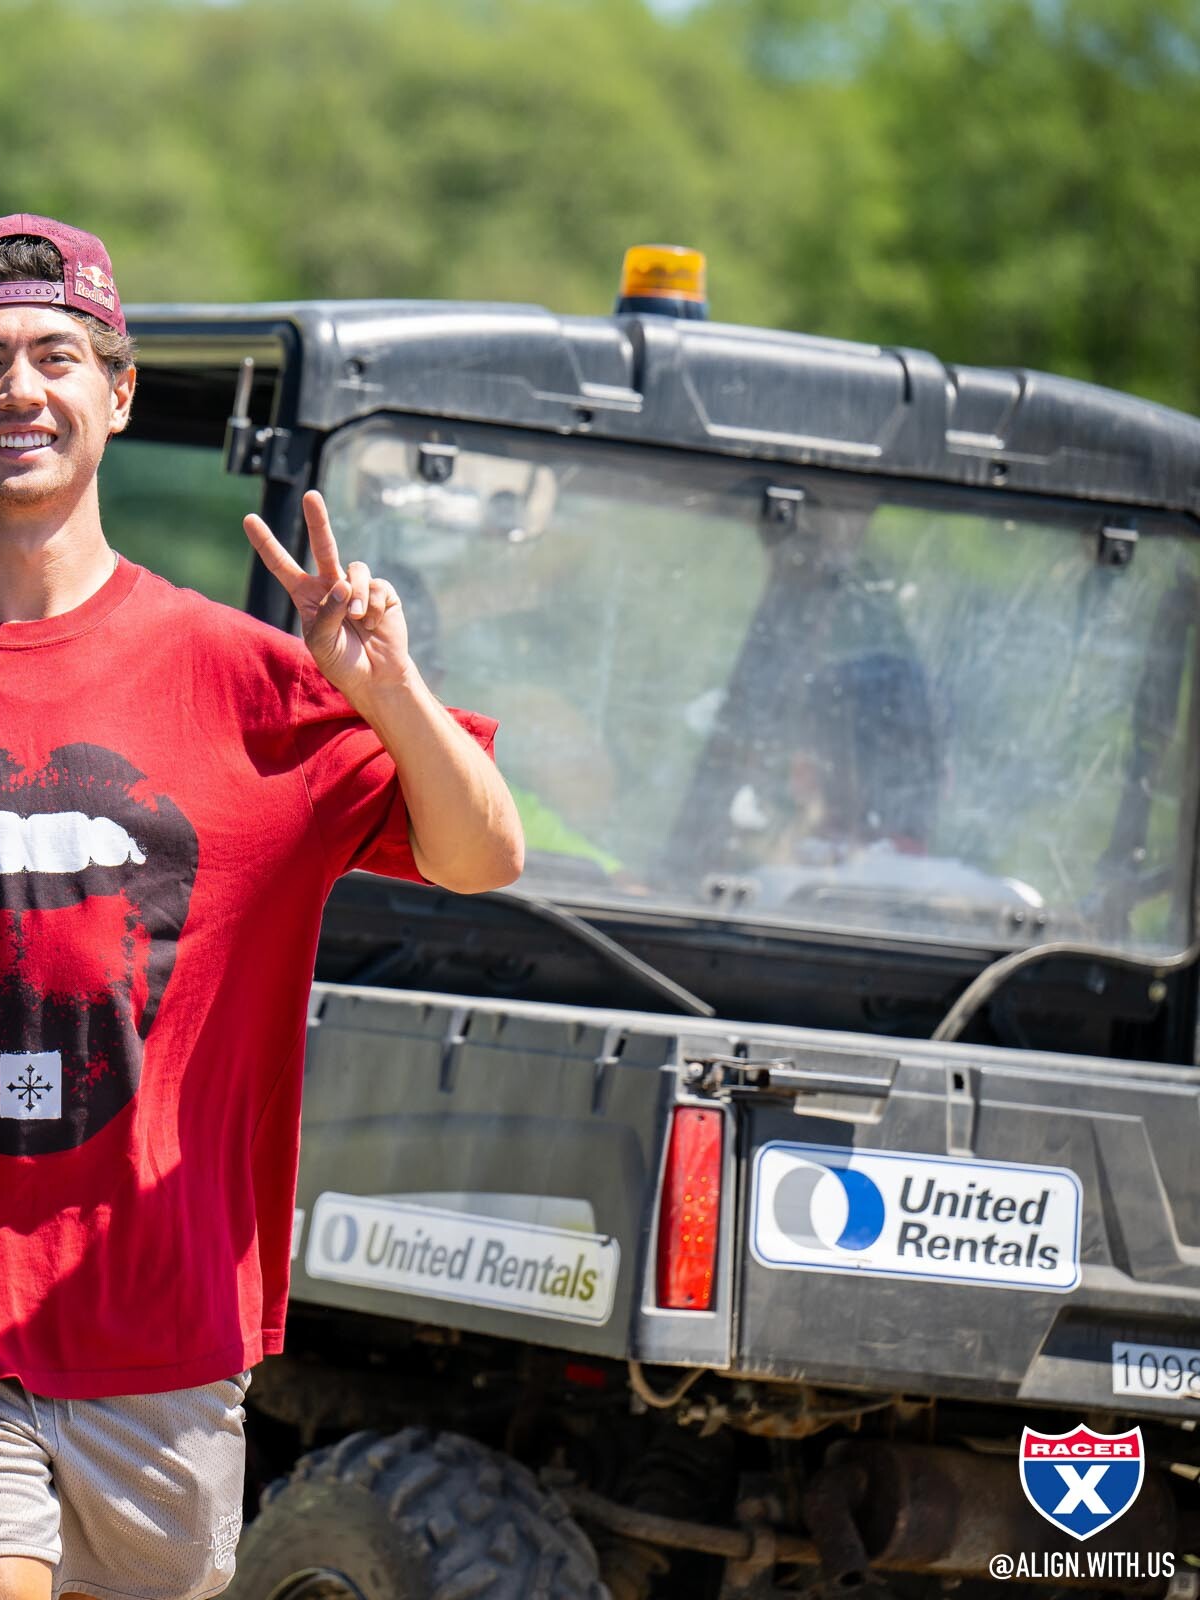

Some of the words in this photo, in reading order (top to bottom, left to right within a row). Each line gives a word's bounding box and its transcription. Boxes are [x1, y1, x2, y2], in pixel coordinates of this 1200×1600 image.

[75, 280, 97, 303] Red
[97, 288, 115, 311] Bull
[899, 1176, 1050, 1226] United
[365, 1221, 473, 1281] United
[475, 1240, 599, 1302] Rentals
[896, 1221, 1060, 1271] Rentals
